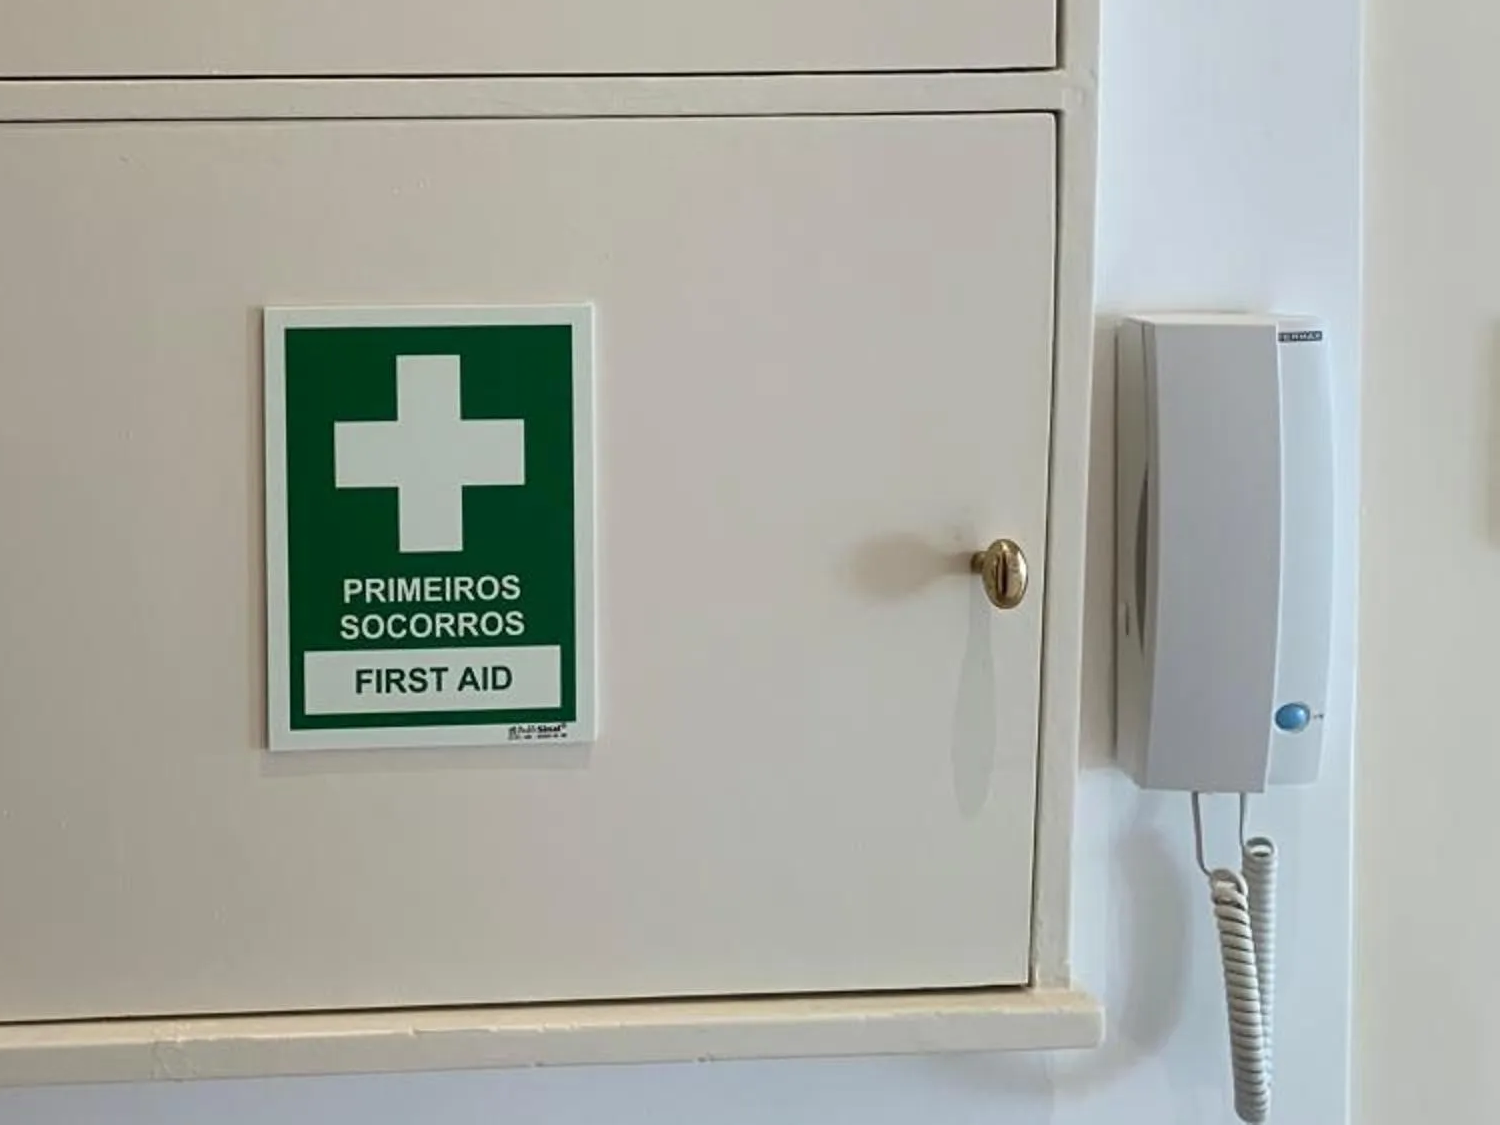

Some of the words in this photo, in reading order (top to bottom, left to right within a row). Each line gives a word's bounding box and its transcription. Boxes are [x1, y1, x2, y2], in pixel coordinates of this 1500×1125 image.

[343, 574, 521, 604] PRIMEIROS
[340, 610, 525, 640] SOCORROS
[355, 667, 448, 694] FIRST
[457, 666, 513, 692] AID
